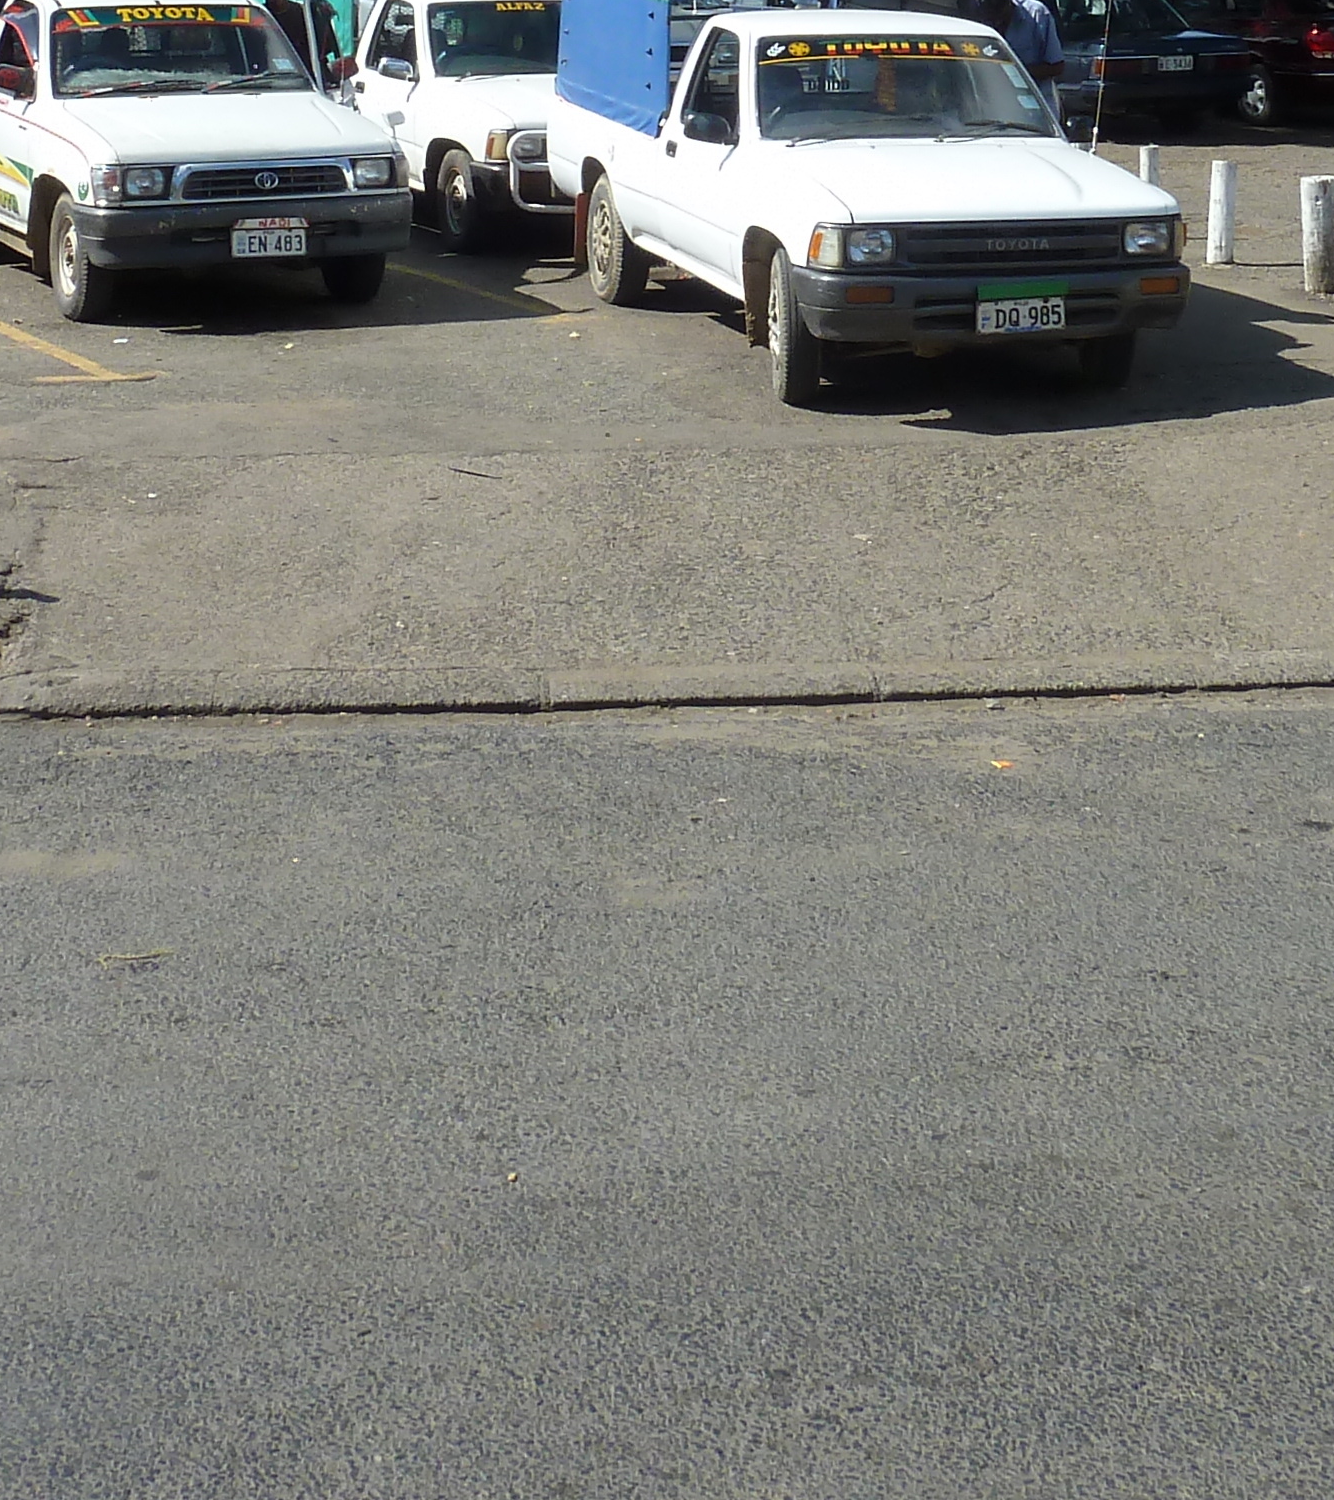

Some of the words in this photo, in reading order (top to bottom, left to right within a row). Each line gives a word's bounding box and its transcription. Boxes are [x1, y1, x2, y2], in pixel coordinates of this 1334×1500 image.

[116, 6, 215, 23] TOYOTA
[496, 2, 546, 11] ALFAZ
[819, 37, 955, 56] TOYOTA
[248, 235, 268, 254] EN
[274, 234, 303, 253] 483
[987, 239, 1049, 251] TOYOTA
[995, 307, 1020, 329] DQ
[1028, 303, 1063, 328] 985
